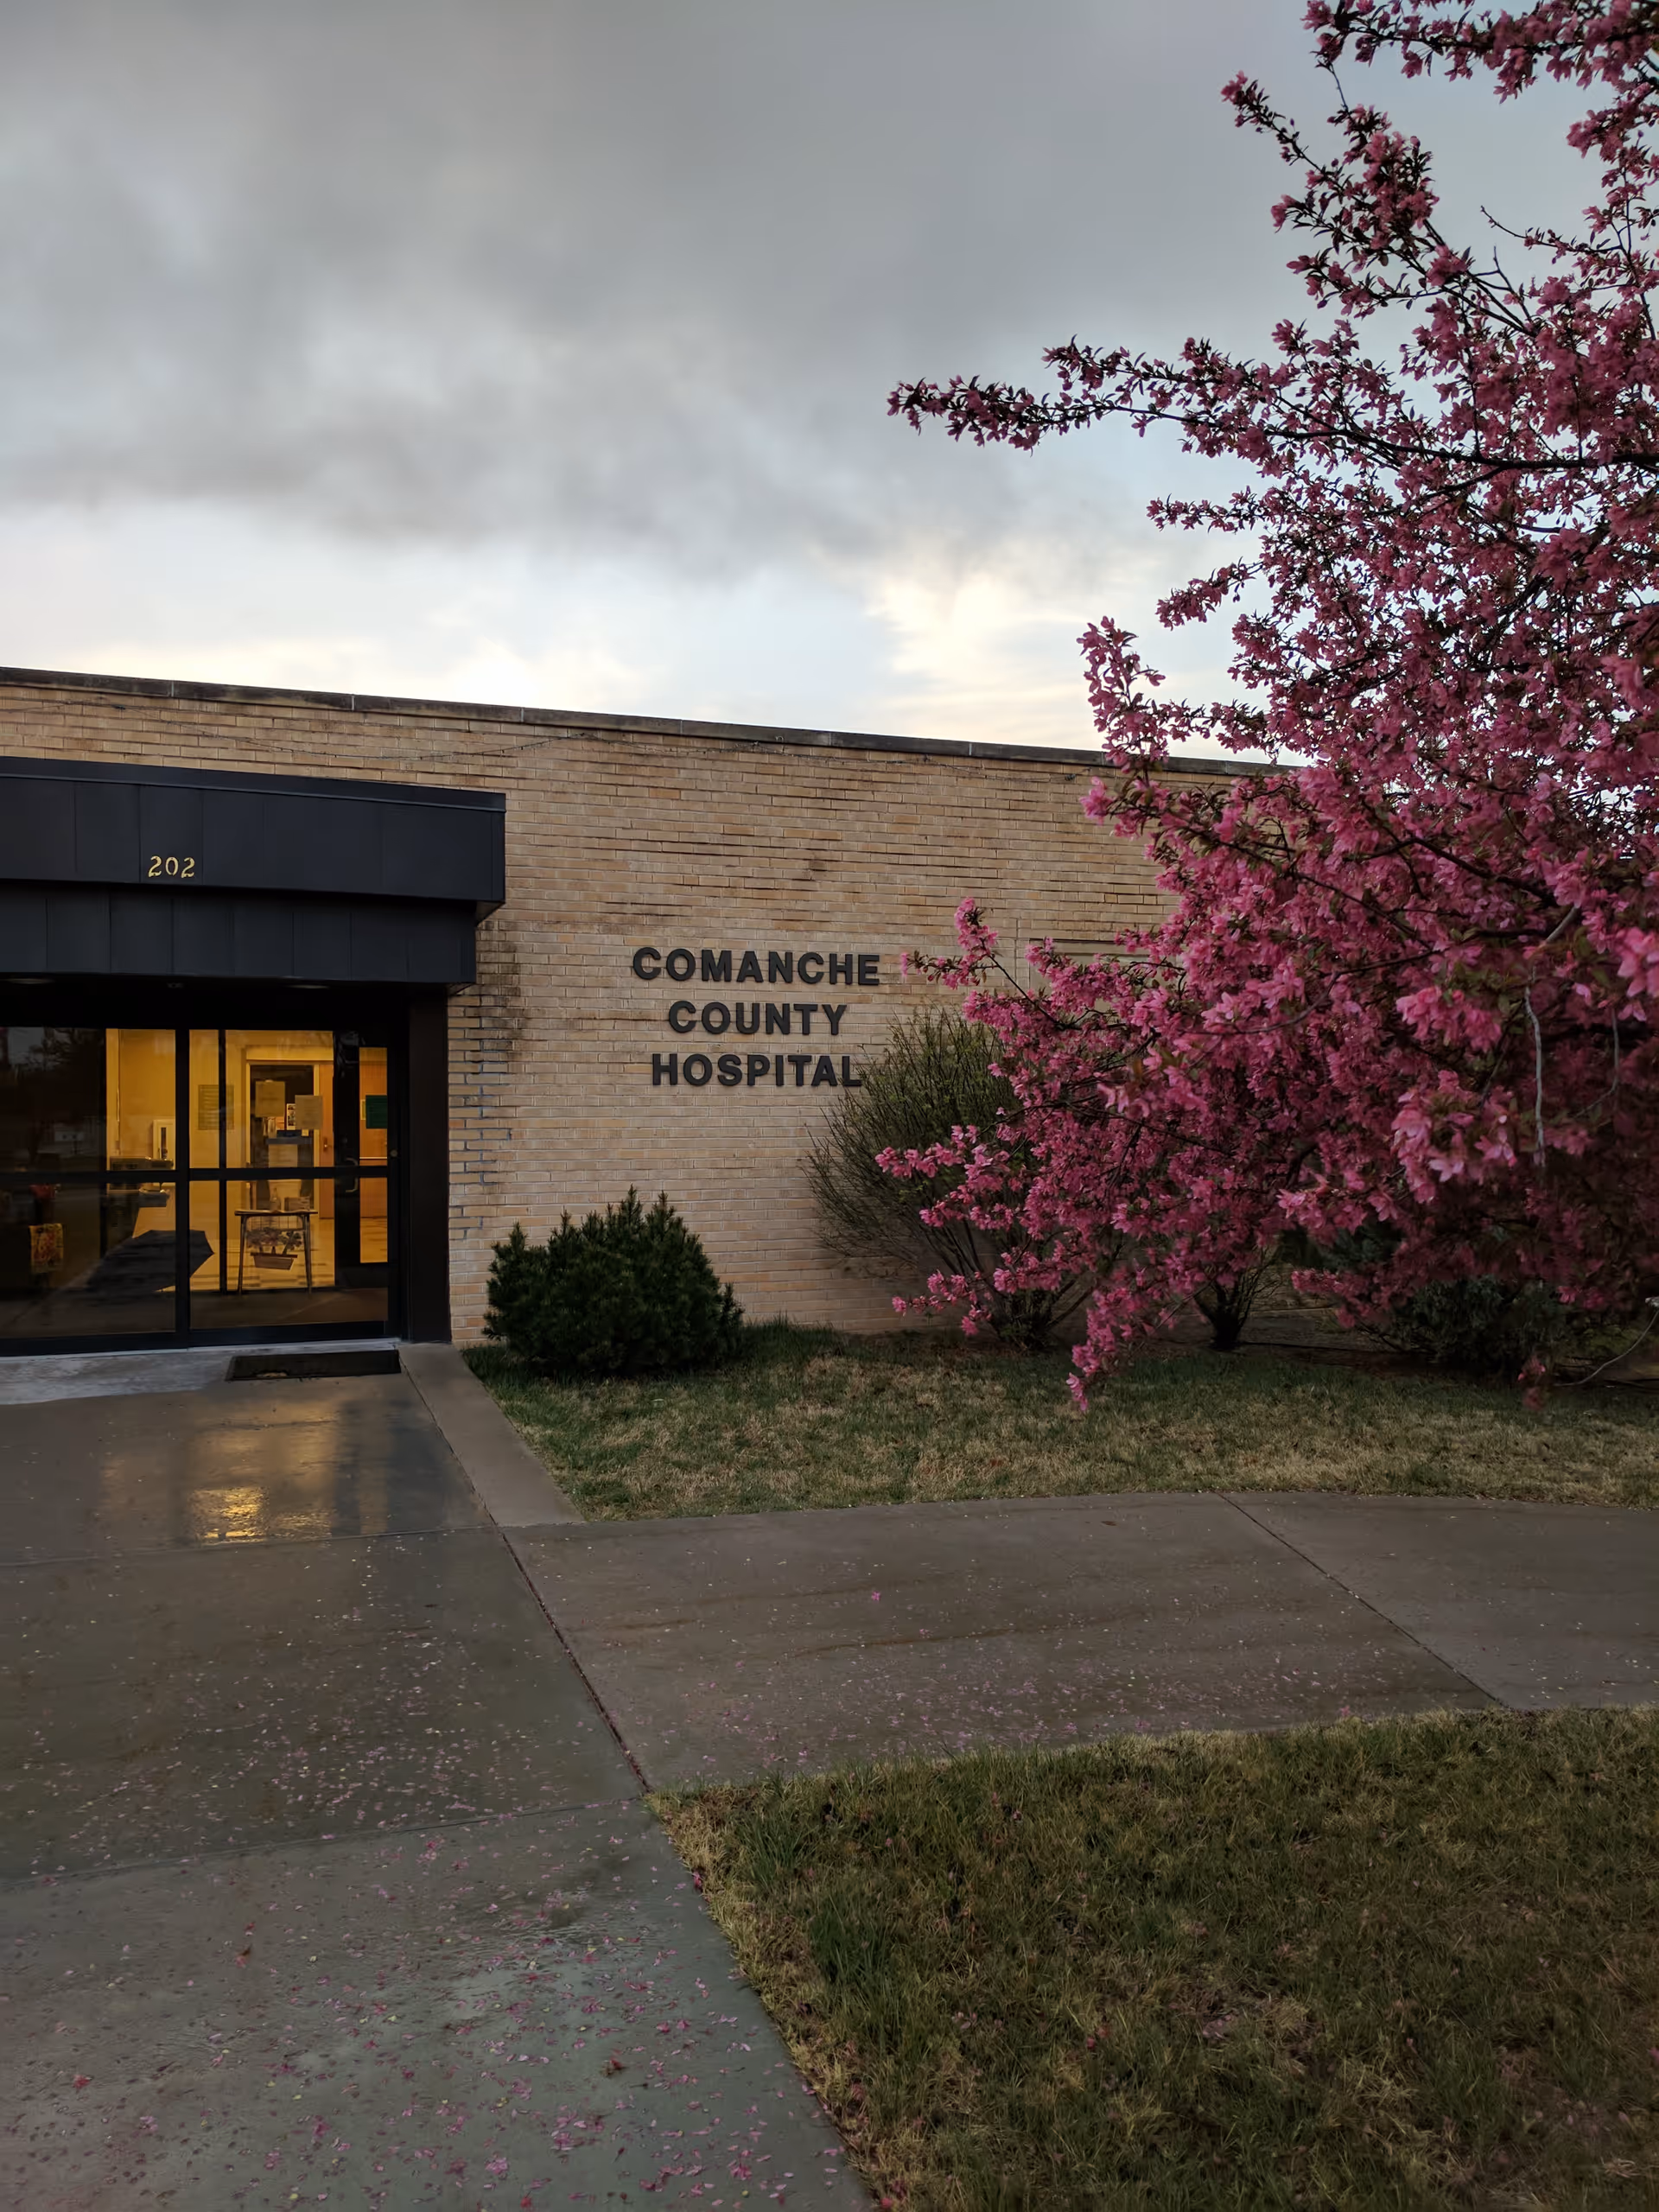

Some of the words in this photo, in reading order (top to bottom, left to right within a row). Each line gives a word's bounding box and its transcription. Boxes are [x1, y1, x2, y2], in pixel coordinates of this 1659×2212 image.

[148, 855, 195, 878] 202
[632, 947, 880, 986] COMANCHE
[668, 1001, 848, 1035] COUNTY
[652, 1053, 862, 1087] HOSPITAL
